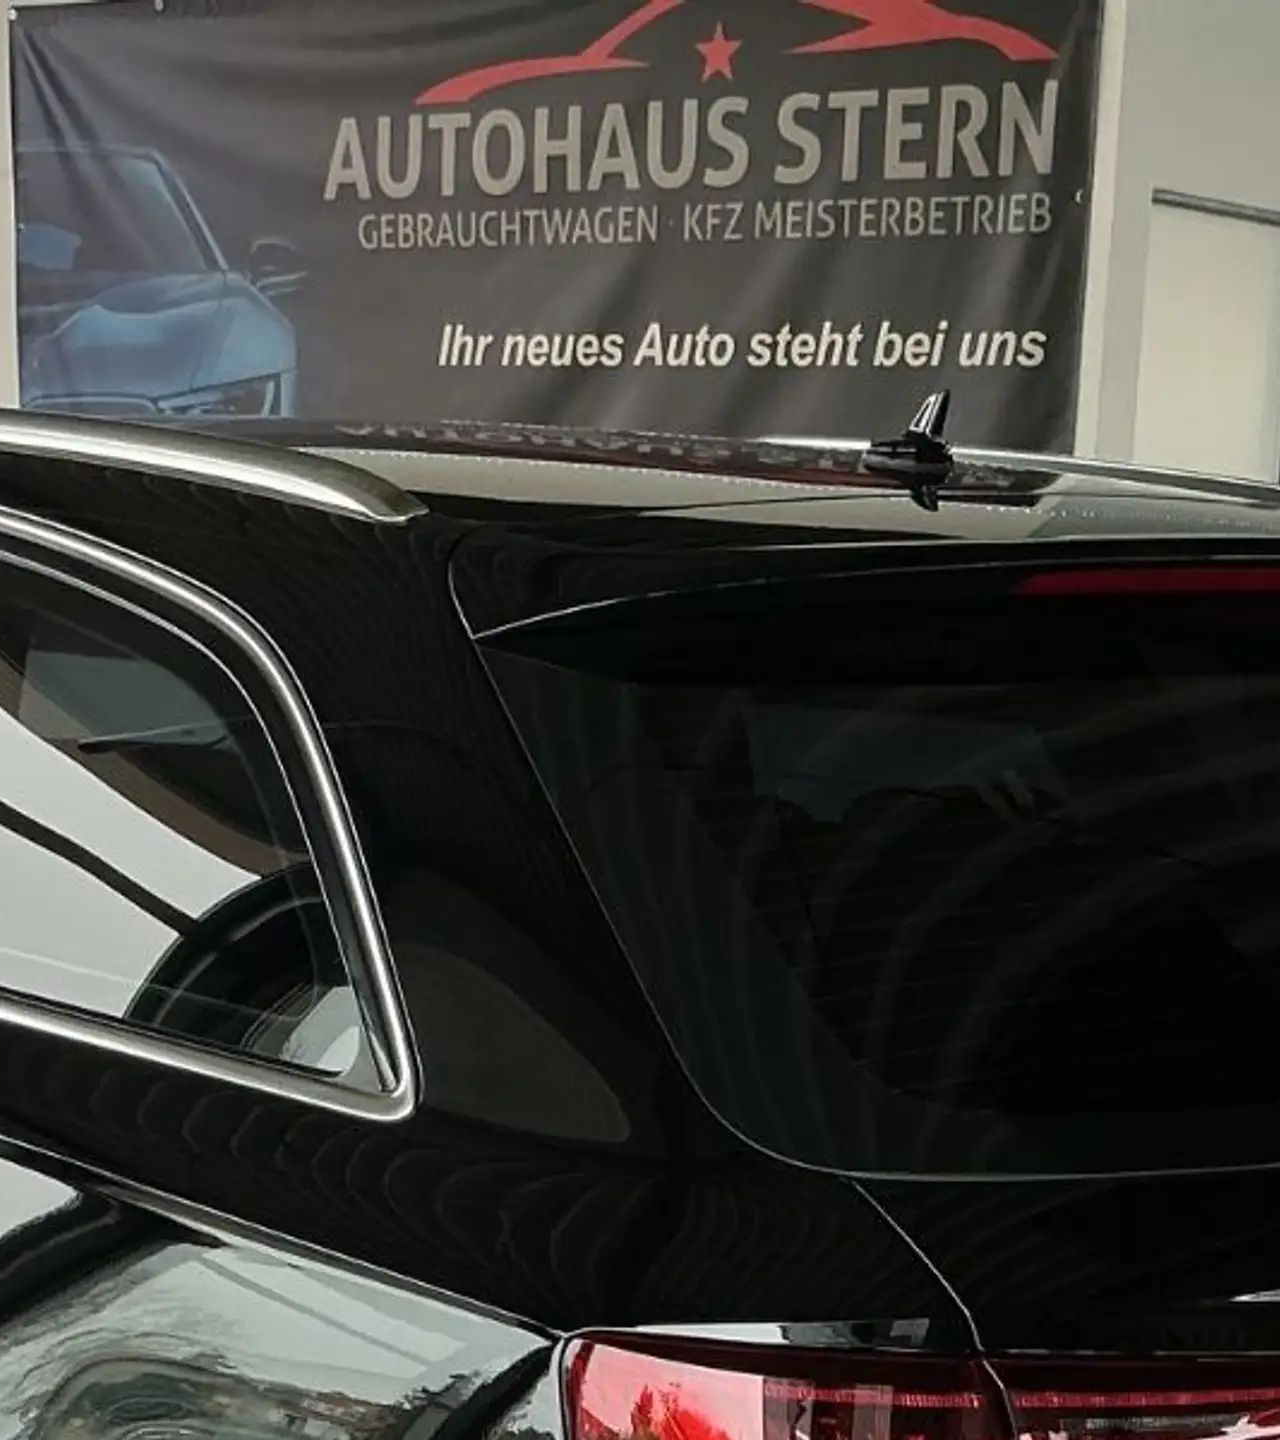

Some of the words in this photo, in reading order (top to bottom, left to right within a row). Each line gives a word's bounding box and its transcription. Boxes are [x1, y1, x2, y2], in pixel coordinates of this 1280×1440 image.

[323, 95, 750, 201] AUTOHAUS
[773, 79, 1059, 185] STERN
[357, 205, 658, 250] GEBRAUCHTWAGEN
[683, 202, 744, 243] KFZ
[754, 192, 1052, 241] MEISTERBETRIEB
[437, 322, 493, 368] Ihr
[501, 332, 625, 368] neues
[633, 322, 735, 368] Auto
[746, 320, 865, 367] steht
[872, 319, 949, 367] bei
[957, 329, 1048, 367] uns
